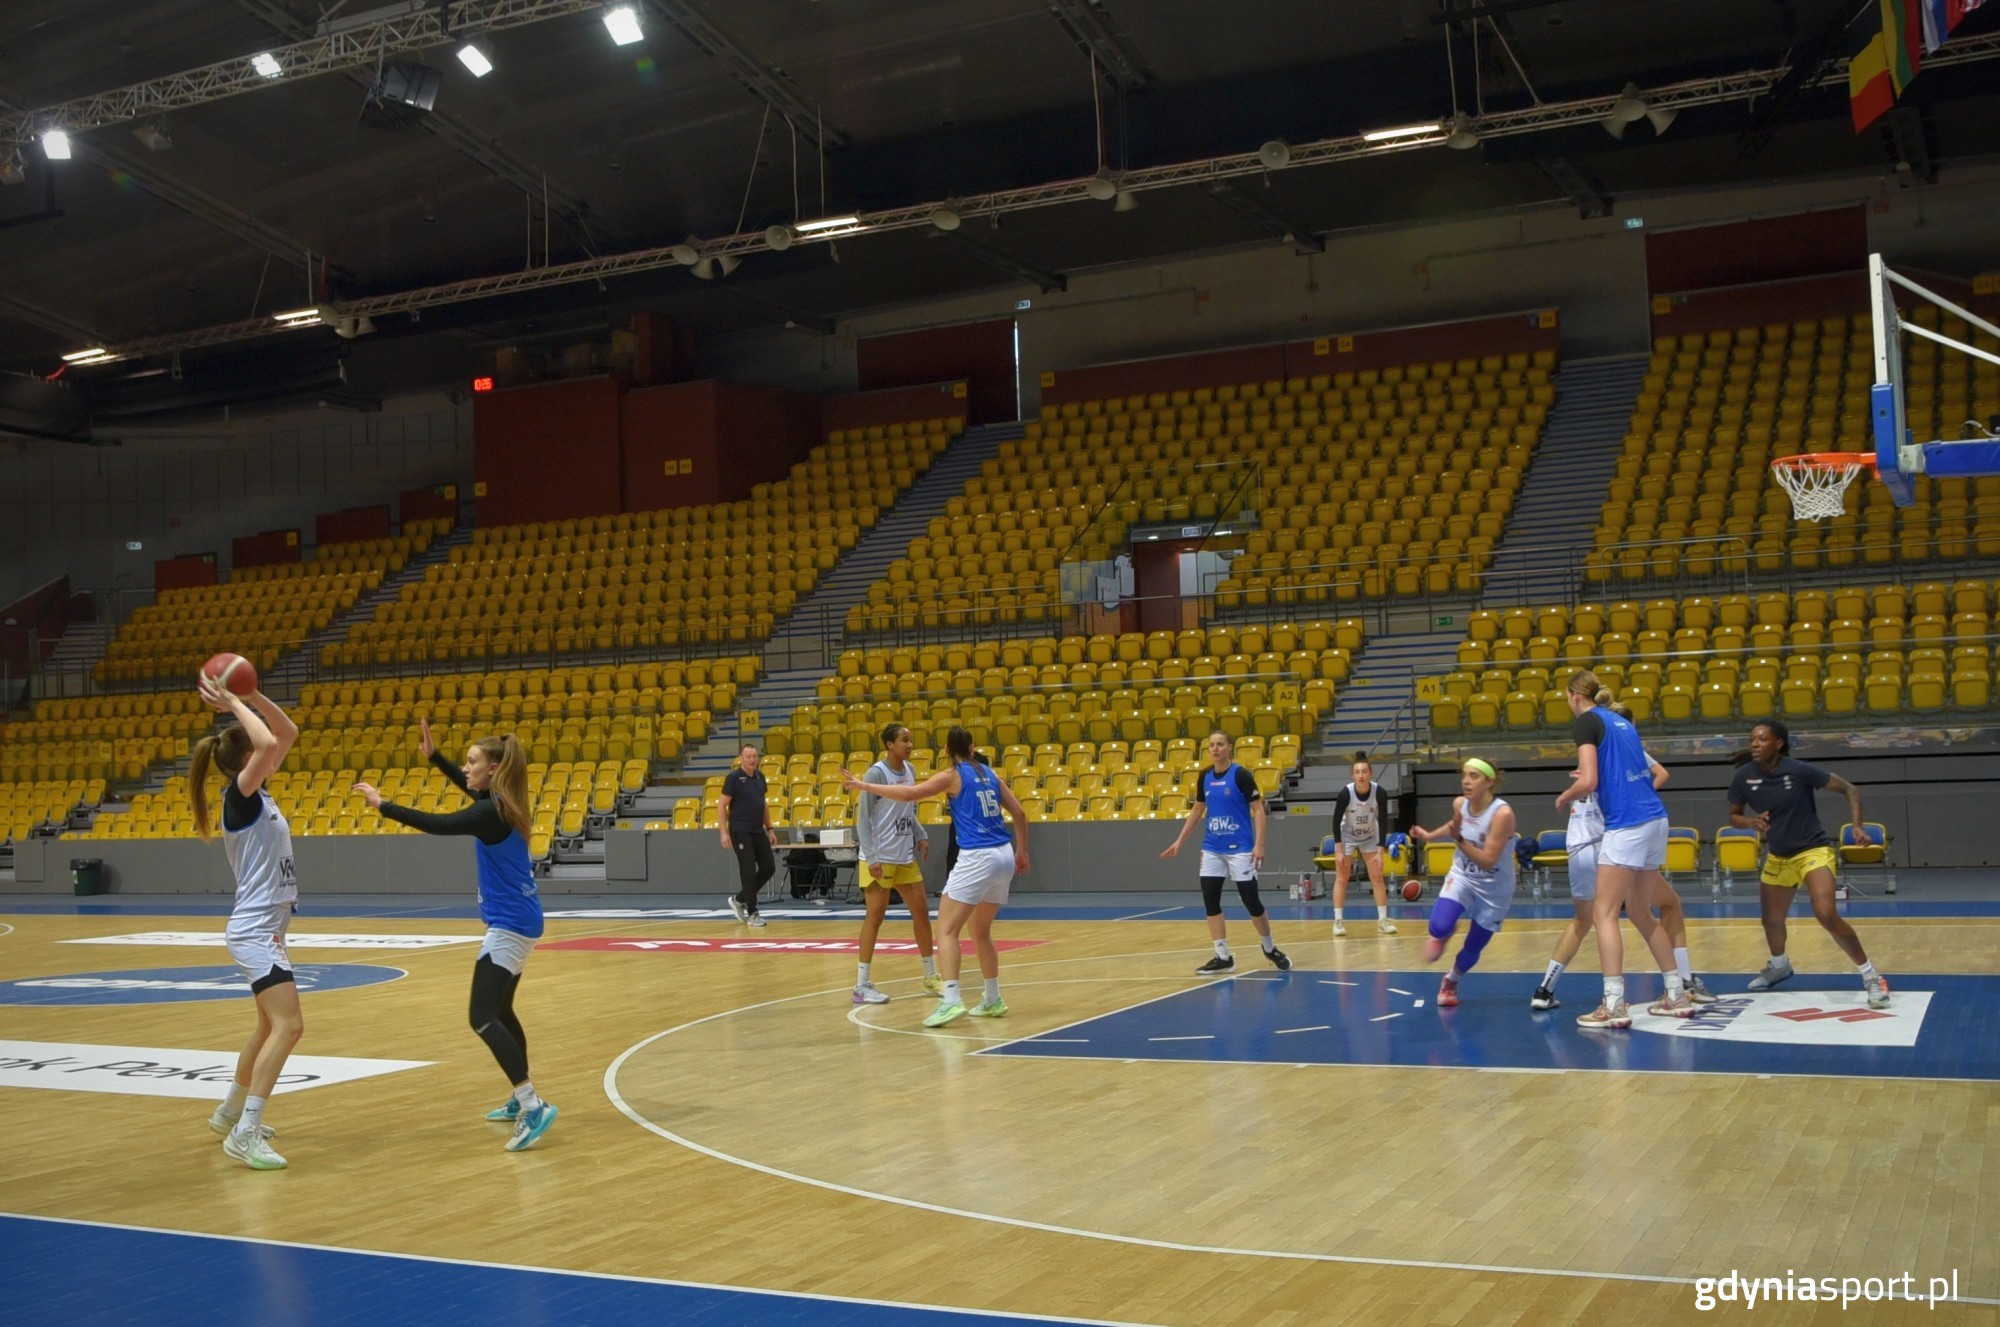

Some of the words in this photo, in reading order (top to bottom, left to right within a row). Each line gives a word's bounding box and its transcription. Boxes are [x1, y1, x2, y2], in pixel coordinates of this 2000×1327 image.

[1422, 684, 1436, 694] A1
[1280, 691, 1294, 700] A2
[638, 722, 650, 730] A6
[744, 717, 756, 725] A5
[975, 789, 1000, 818] 15
[1356, 815, 1368, 825] 92
[1676, 997, 1756, 1032] SUZUKI
